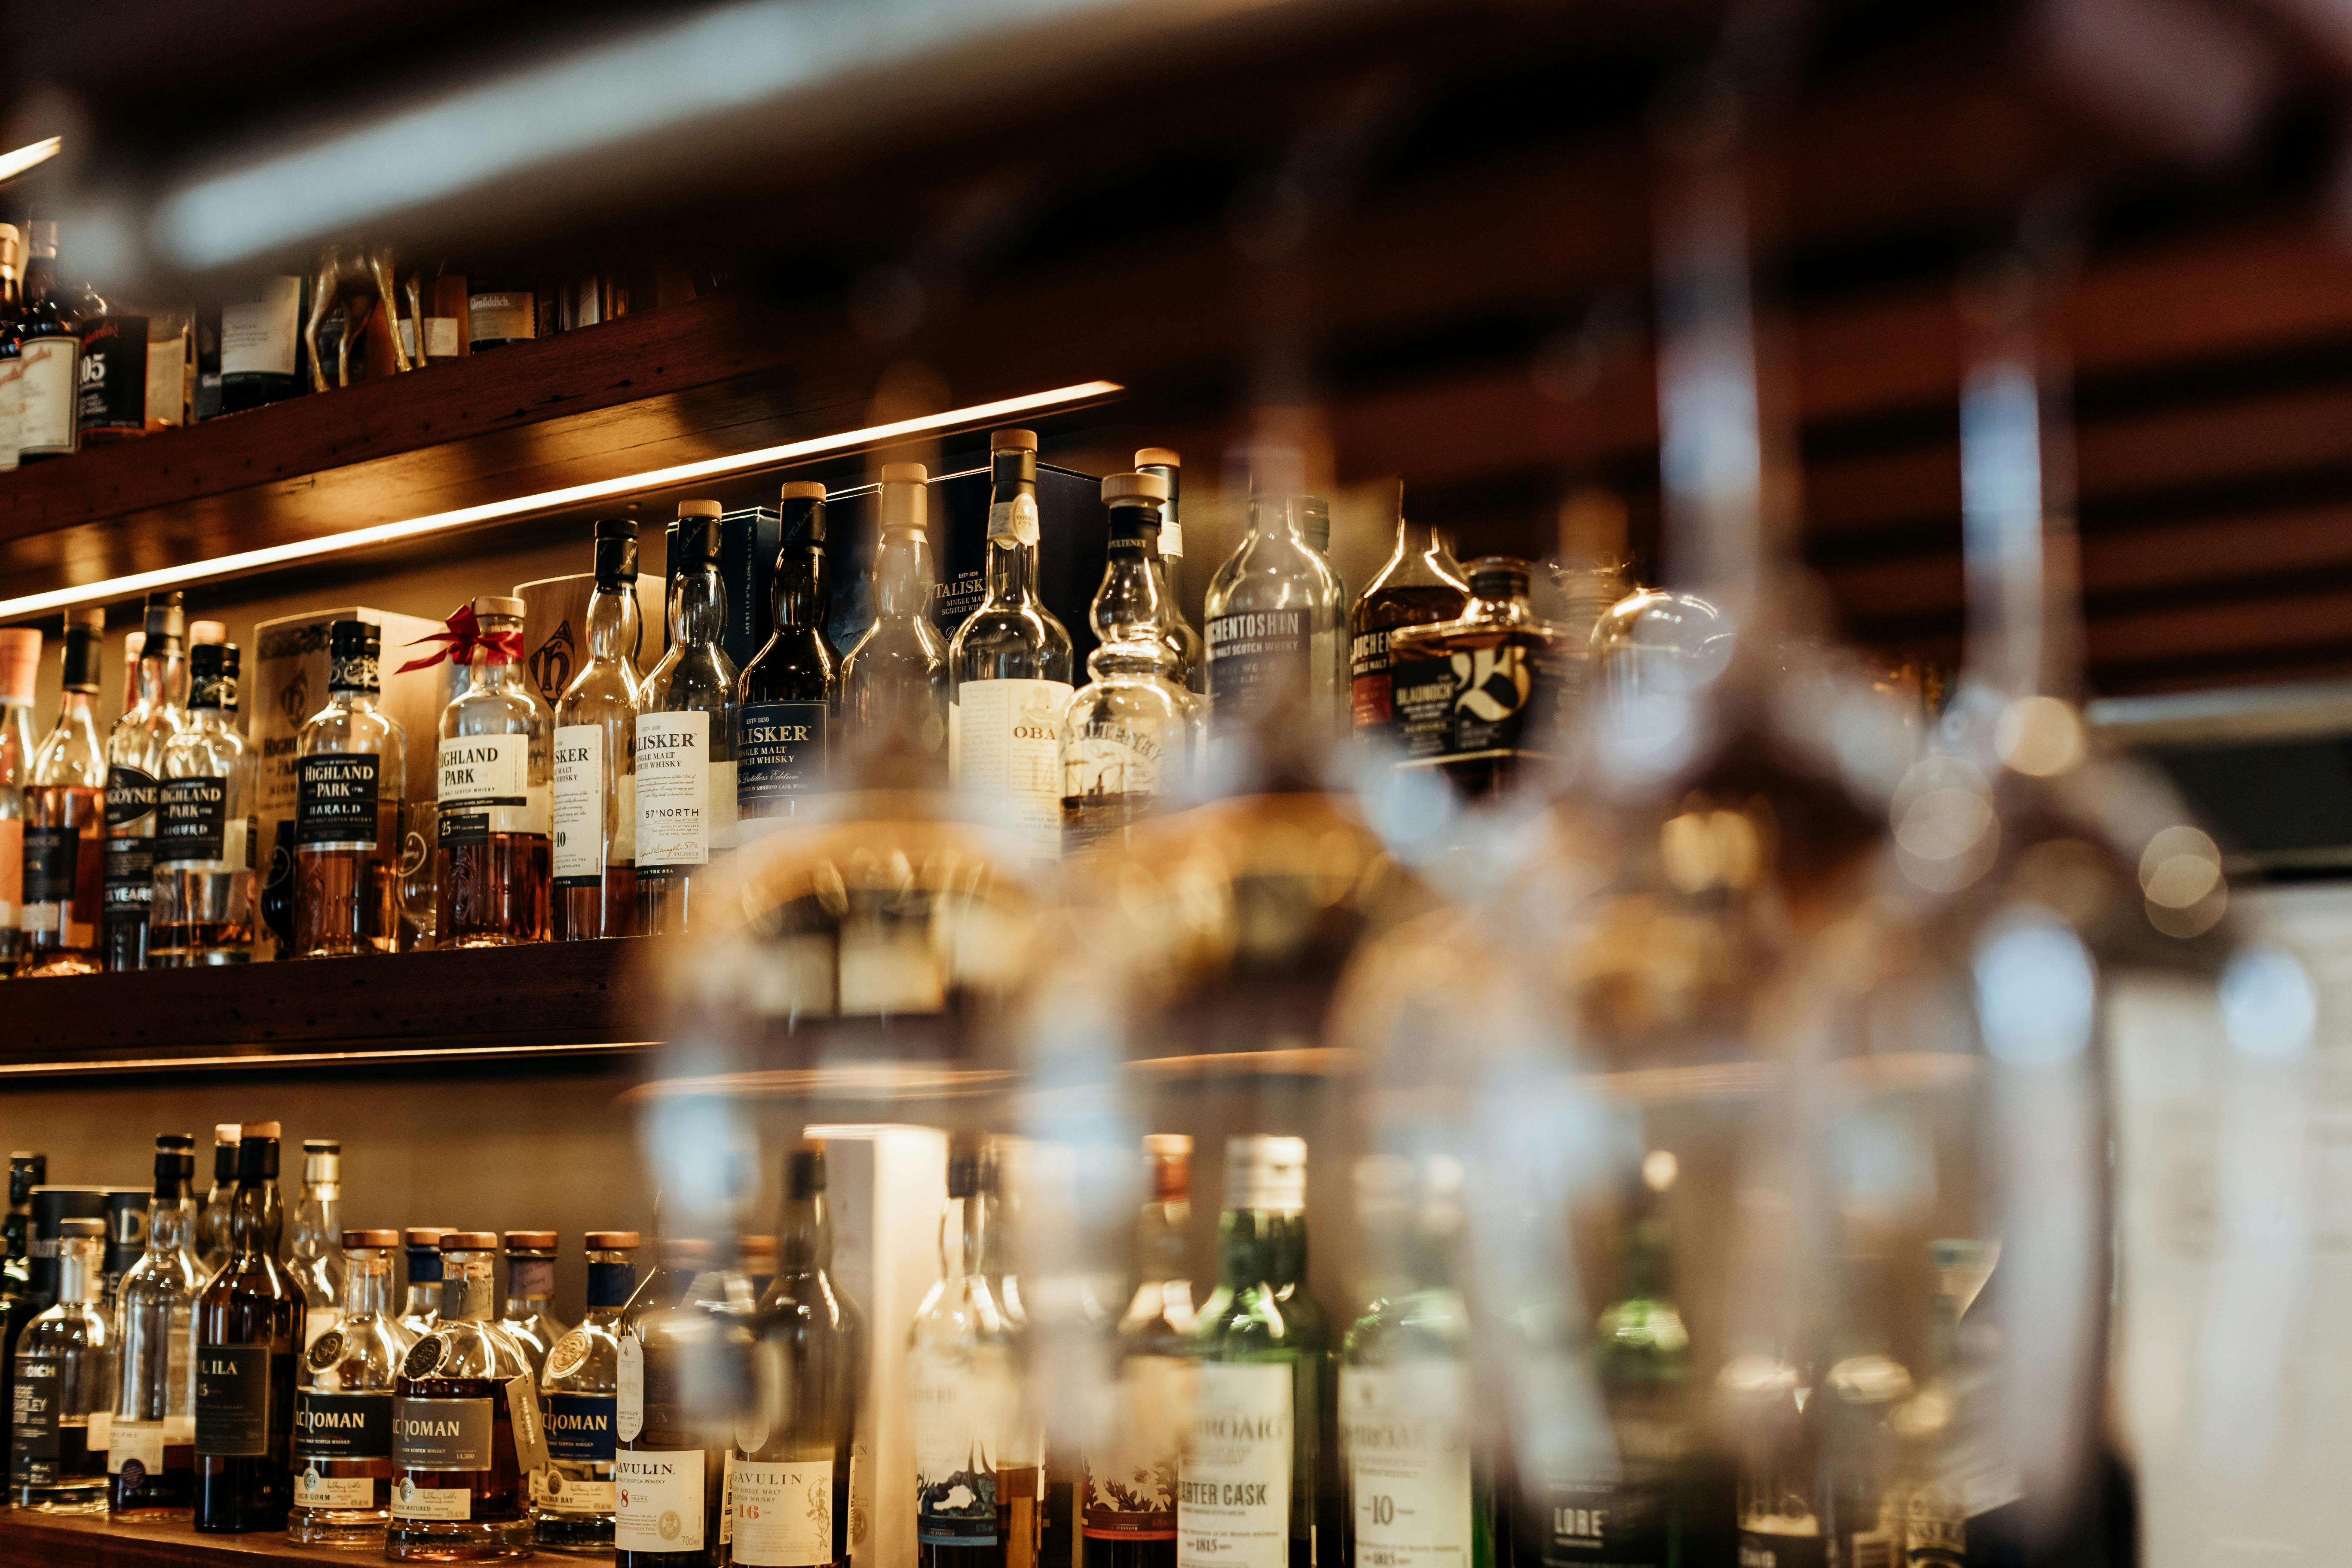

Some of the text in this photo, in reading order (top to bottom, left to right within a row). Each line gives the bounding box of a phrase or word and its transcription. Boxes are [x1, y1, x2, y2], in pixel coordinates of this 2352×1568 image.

[947, 598, 969, 606] SINGLE
[942, 606, 966, 615] SCOTCH
[761, 746, 787, 754] MALT
[757, 756, 795, 764] WHISKY
[305, 766, 374, 782] HIGHLAND
[445, 769, 474, 787] PARK
[770, 769, 800, 781] Edition
[317, 783, 351, 798] PARK
[310, 804, 361, 815] HARALD
[441, 821, 451, 836] 25
[557, 831, 566, 848] 10
[621, 1489, 628, 1507] 8
[1223, 1483, 1268, 1506] CASK
[739, 1504, 760, 1519] 16
[1373, 1494, 1394, 1527] 10
